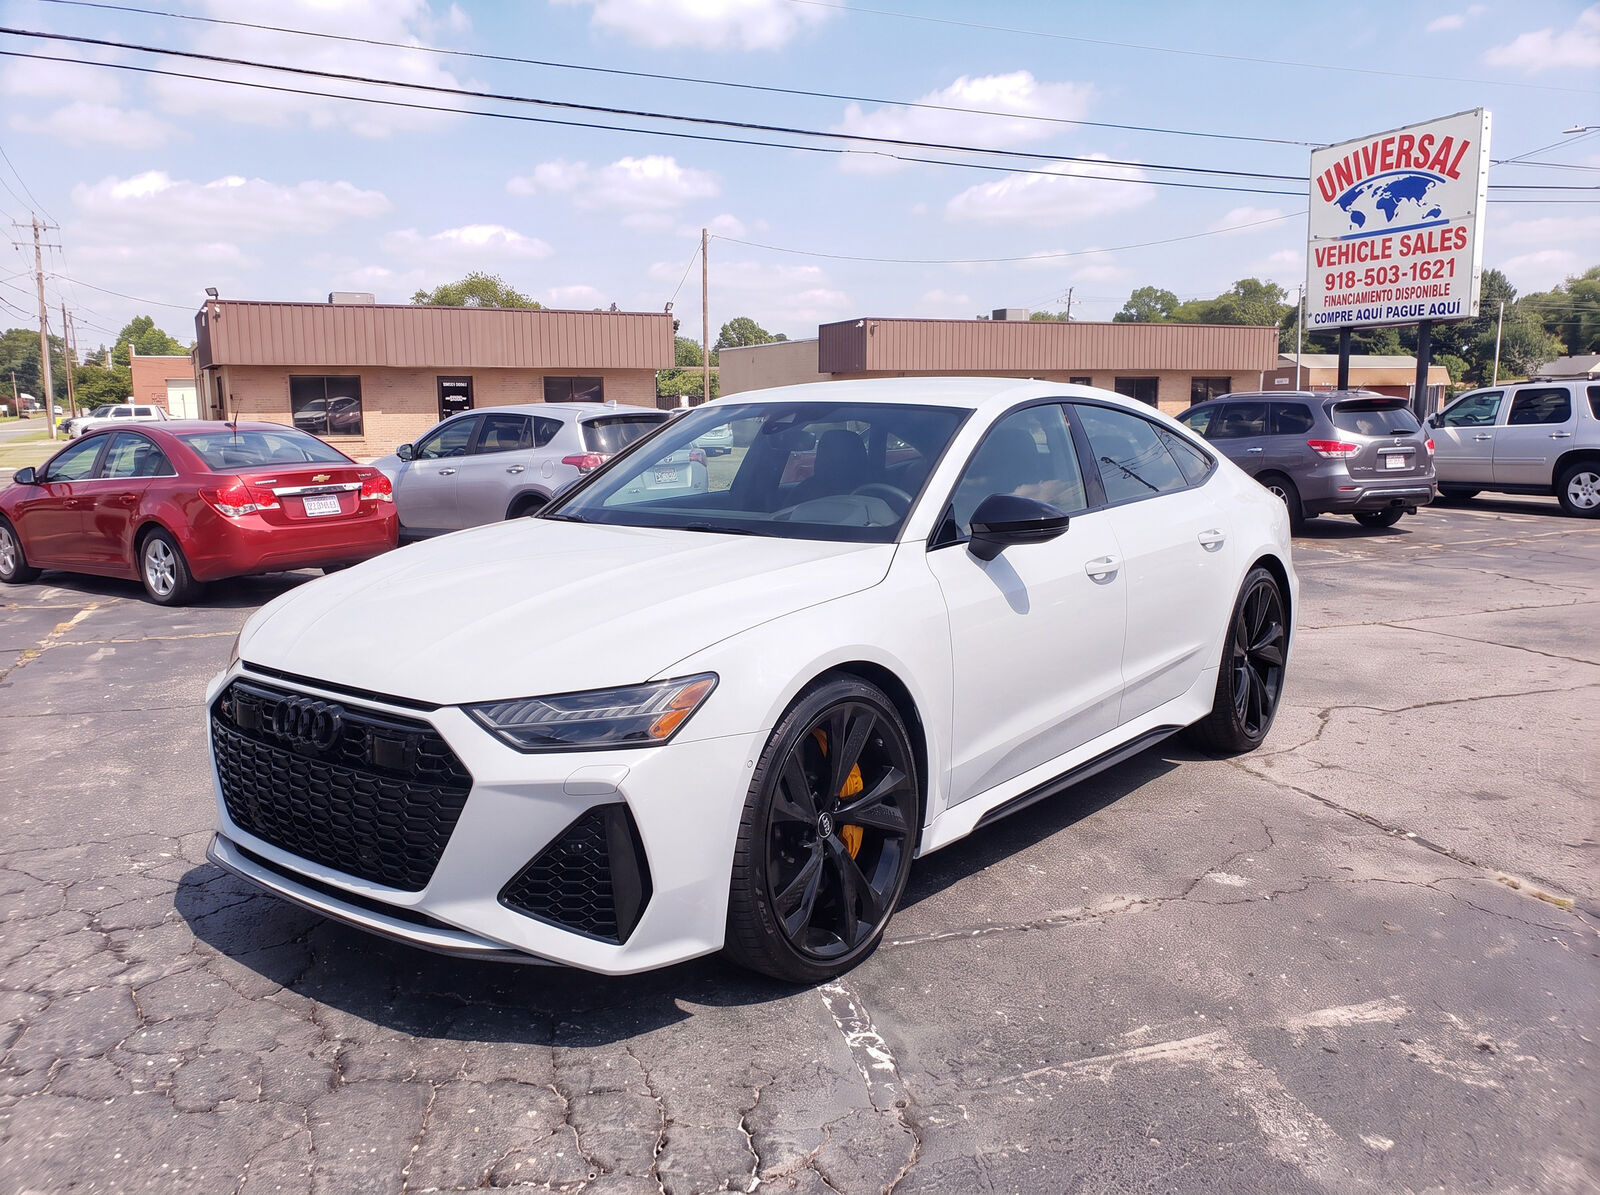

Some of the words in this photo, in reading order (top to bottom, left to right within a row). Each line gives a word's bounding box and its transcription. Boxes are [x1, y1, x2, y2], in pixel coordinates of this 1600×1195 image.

[1316, 133, 1471, 203] UNIVERSAL
[1315, 238, 1393, 267] VEHICLE
[1399, 226, 1467, 257] SALES
[1325, 258, 1455, 291] 918-503-1621
[1324, 289, 1392, 307] FINANCIAMIENTO
[1396, 283, 1450, 300] DISPONIBLE
[1314, 310, 1353, 324] COMPRE
[1386, 303, 1425, 319] PAGUE
